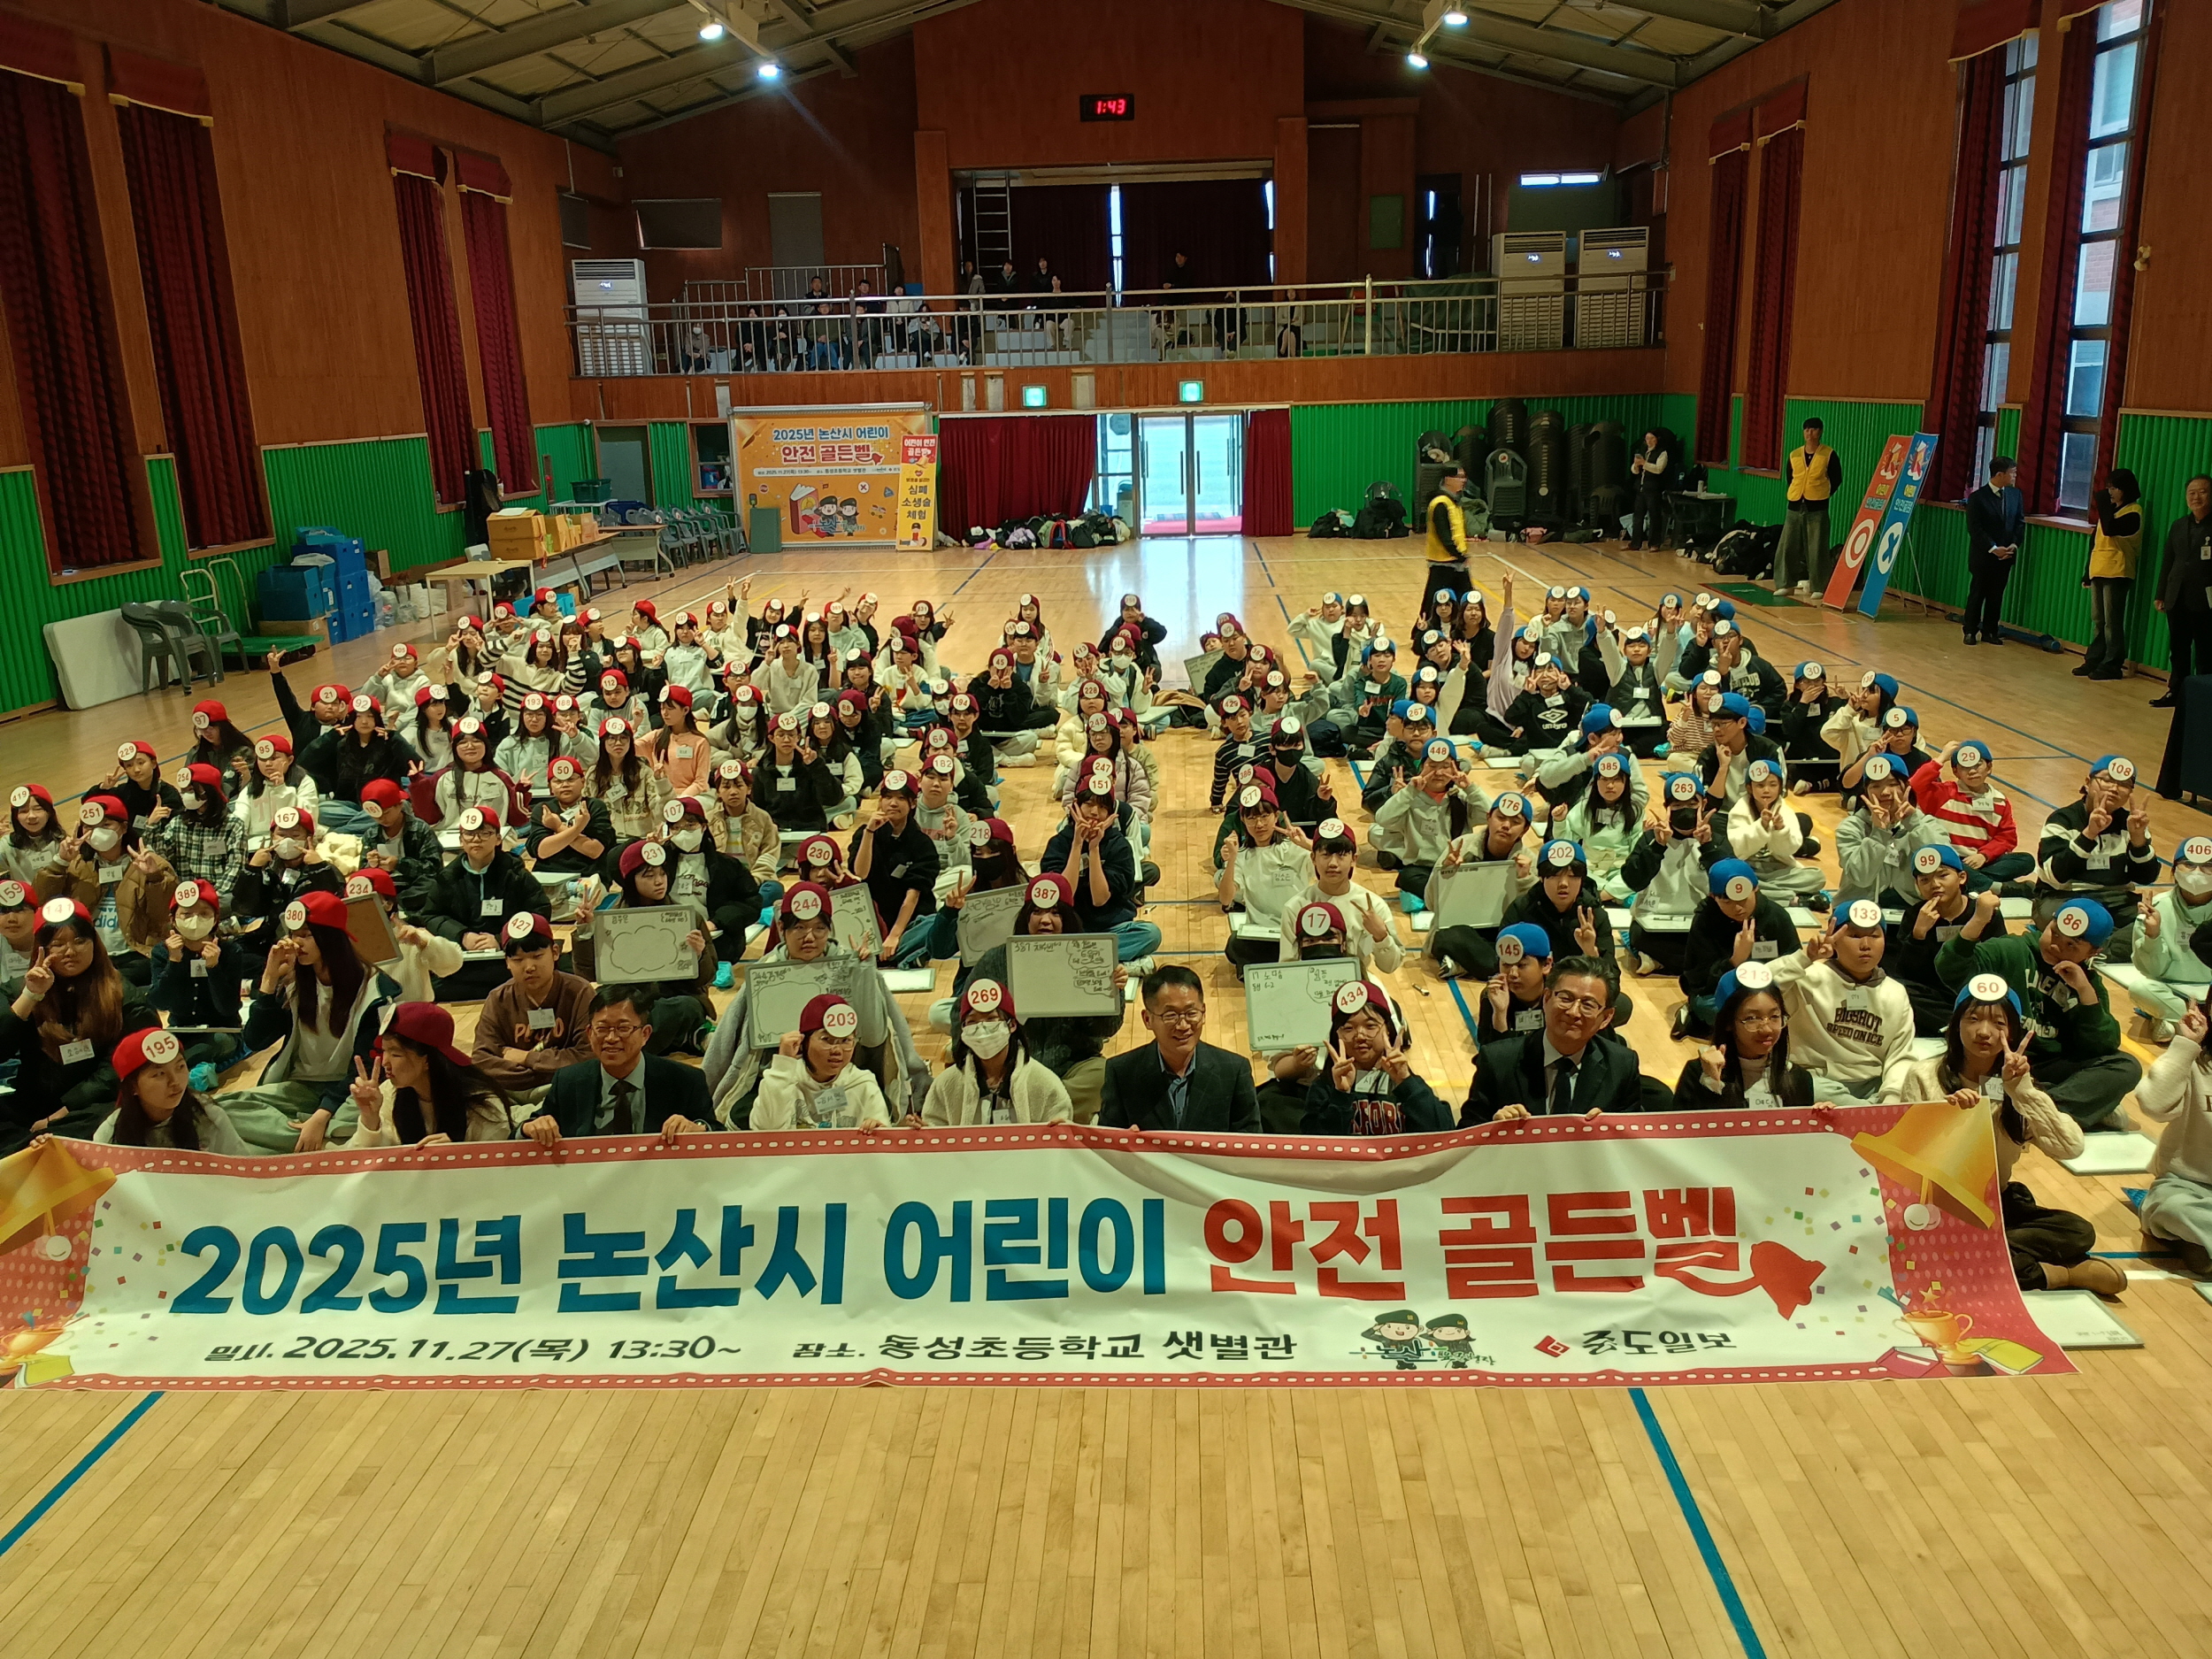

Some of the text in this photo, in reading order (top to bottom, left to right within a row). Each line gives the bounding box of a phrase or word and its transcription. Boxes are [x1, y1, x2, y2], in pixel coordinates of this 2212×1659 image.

[1096, 99, 1126, 115] 1:43
[773, 426, 889, 441] 2025년 논산시 어린이
[782, 444, 872, 464] 안전 골든벨
[908, 485, 928, 495] 심폐
[902, 497, 931, 507] 소생술
[906, 510, 926, 520] 체험
[1806, 666, 1819, 675] 30
[356, 699, 368, 708] 92
[195, 715, 206, 725] 97
[607, 721, 623, 730] 163
[780, 717, 795, 726] 123
[1090, 718, 1105, 726] 248
[119, 747, 134, 757] 229
[259, 744, 270, 754] 95
[1962, 752, 1975, 762] 29
[1095, 763, 1110, 772] 247
[1751, 765, 1768, 776] 134
[1873, 764, 1883, 773] 11
[2110, 762, 2131, 776] 108
[1093, 780, 1109, 789] 151
[1674, 784, 1694, 793] 263
[12, 791, 27, 802] 419
[1243, 790, 1257, 803] 277
[664, 804, 682, 816] 107
[1502, 799, 1519, 810] 176
[82, 808, 101, 818] 251
[277, 813, 296, 823] 167
[465, 814, 476, 824] 19
[970, 827, 990, 839] 218
[1321, 823, 1340, 833] 232
[643, 848, 664, 859] 231
[810, 847, 833, 859] 230
[1549, 848, 1573, 858] 202
[2187, 844, 2212, 855] 406
[1920, 855, 1935, 865] 99
[1, 882, 22, 902] 159
[177, 887, 196, 900] 389
[349, 883, 368, 895] 234
[1033, 887, 1056, 900] 387
[1736, 884, 1742, 894] 9
[45, 902, 72, 915] 141
[794, 898, 819, 911] 244
[286, 910, 303, 921] 380
[1853, 908, 1878, 919] 133
[511, 918, 531, 932] 427
[1307, 912, 1328, 928] 17
[2062, 913, 2082, 931] 86
[1498, 942, 1520, 956] 145
[1739, 969, 1770, 981] 213
[1976, 981, 2000, 994] 60
[971, 988, 998, 1004] 269
[1340, 987, 1363, 1007] 434
[826, 1013, 856, 1026] 203
[1834, 1007, 1883, 1033] BIGSHOT
[1826, 1023, 1884, 1047] SPEED ON ICE
[146, 1036, 175, 1057] 195
[168, 1187, 1740, 1316] 2025년 논산시 어린이 안전 골든벨
[282, 1335, 589, 1363] 2025.11.27(목)
[608, 1335, 741, 1360] 13:30~
[878, 1333, 1144, 1361] 동성초등학교
[1163, 1330, 1298, 1361] 샛별관
[1582, 1330, 1738, 1356] 중도일보
